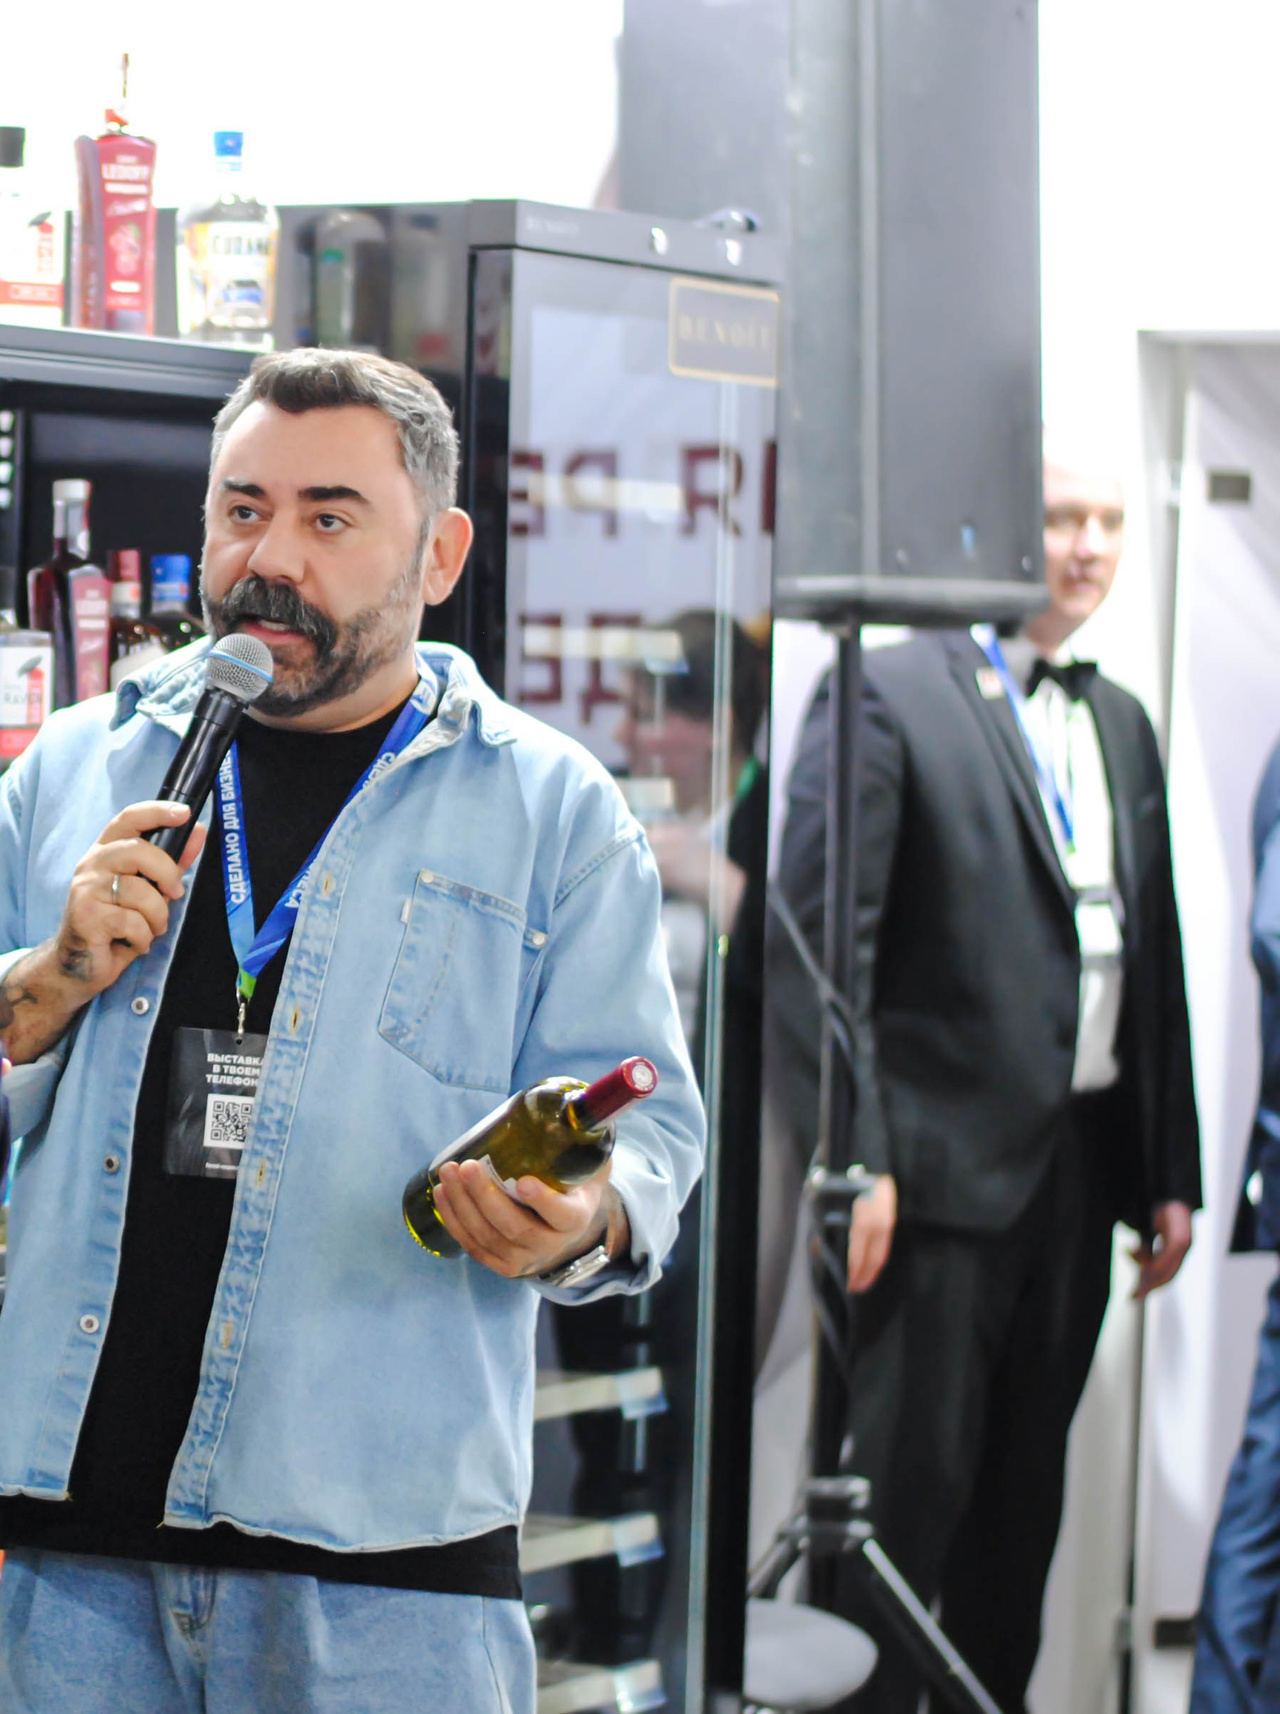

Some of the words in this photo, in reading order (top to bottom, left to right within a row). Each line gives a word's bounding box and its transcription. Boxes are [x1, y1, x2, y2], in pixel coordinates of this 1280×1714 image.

[222, 802, 240, 830] ДЛЯ
[225, 832, 246, 903] СДЕЛАНО
[207, 1053, 264, 1066] ВЫСТАВК
[213, 1065, 220, 1074] В
[223, 1065, 261, 1076] ТВОЕМ
